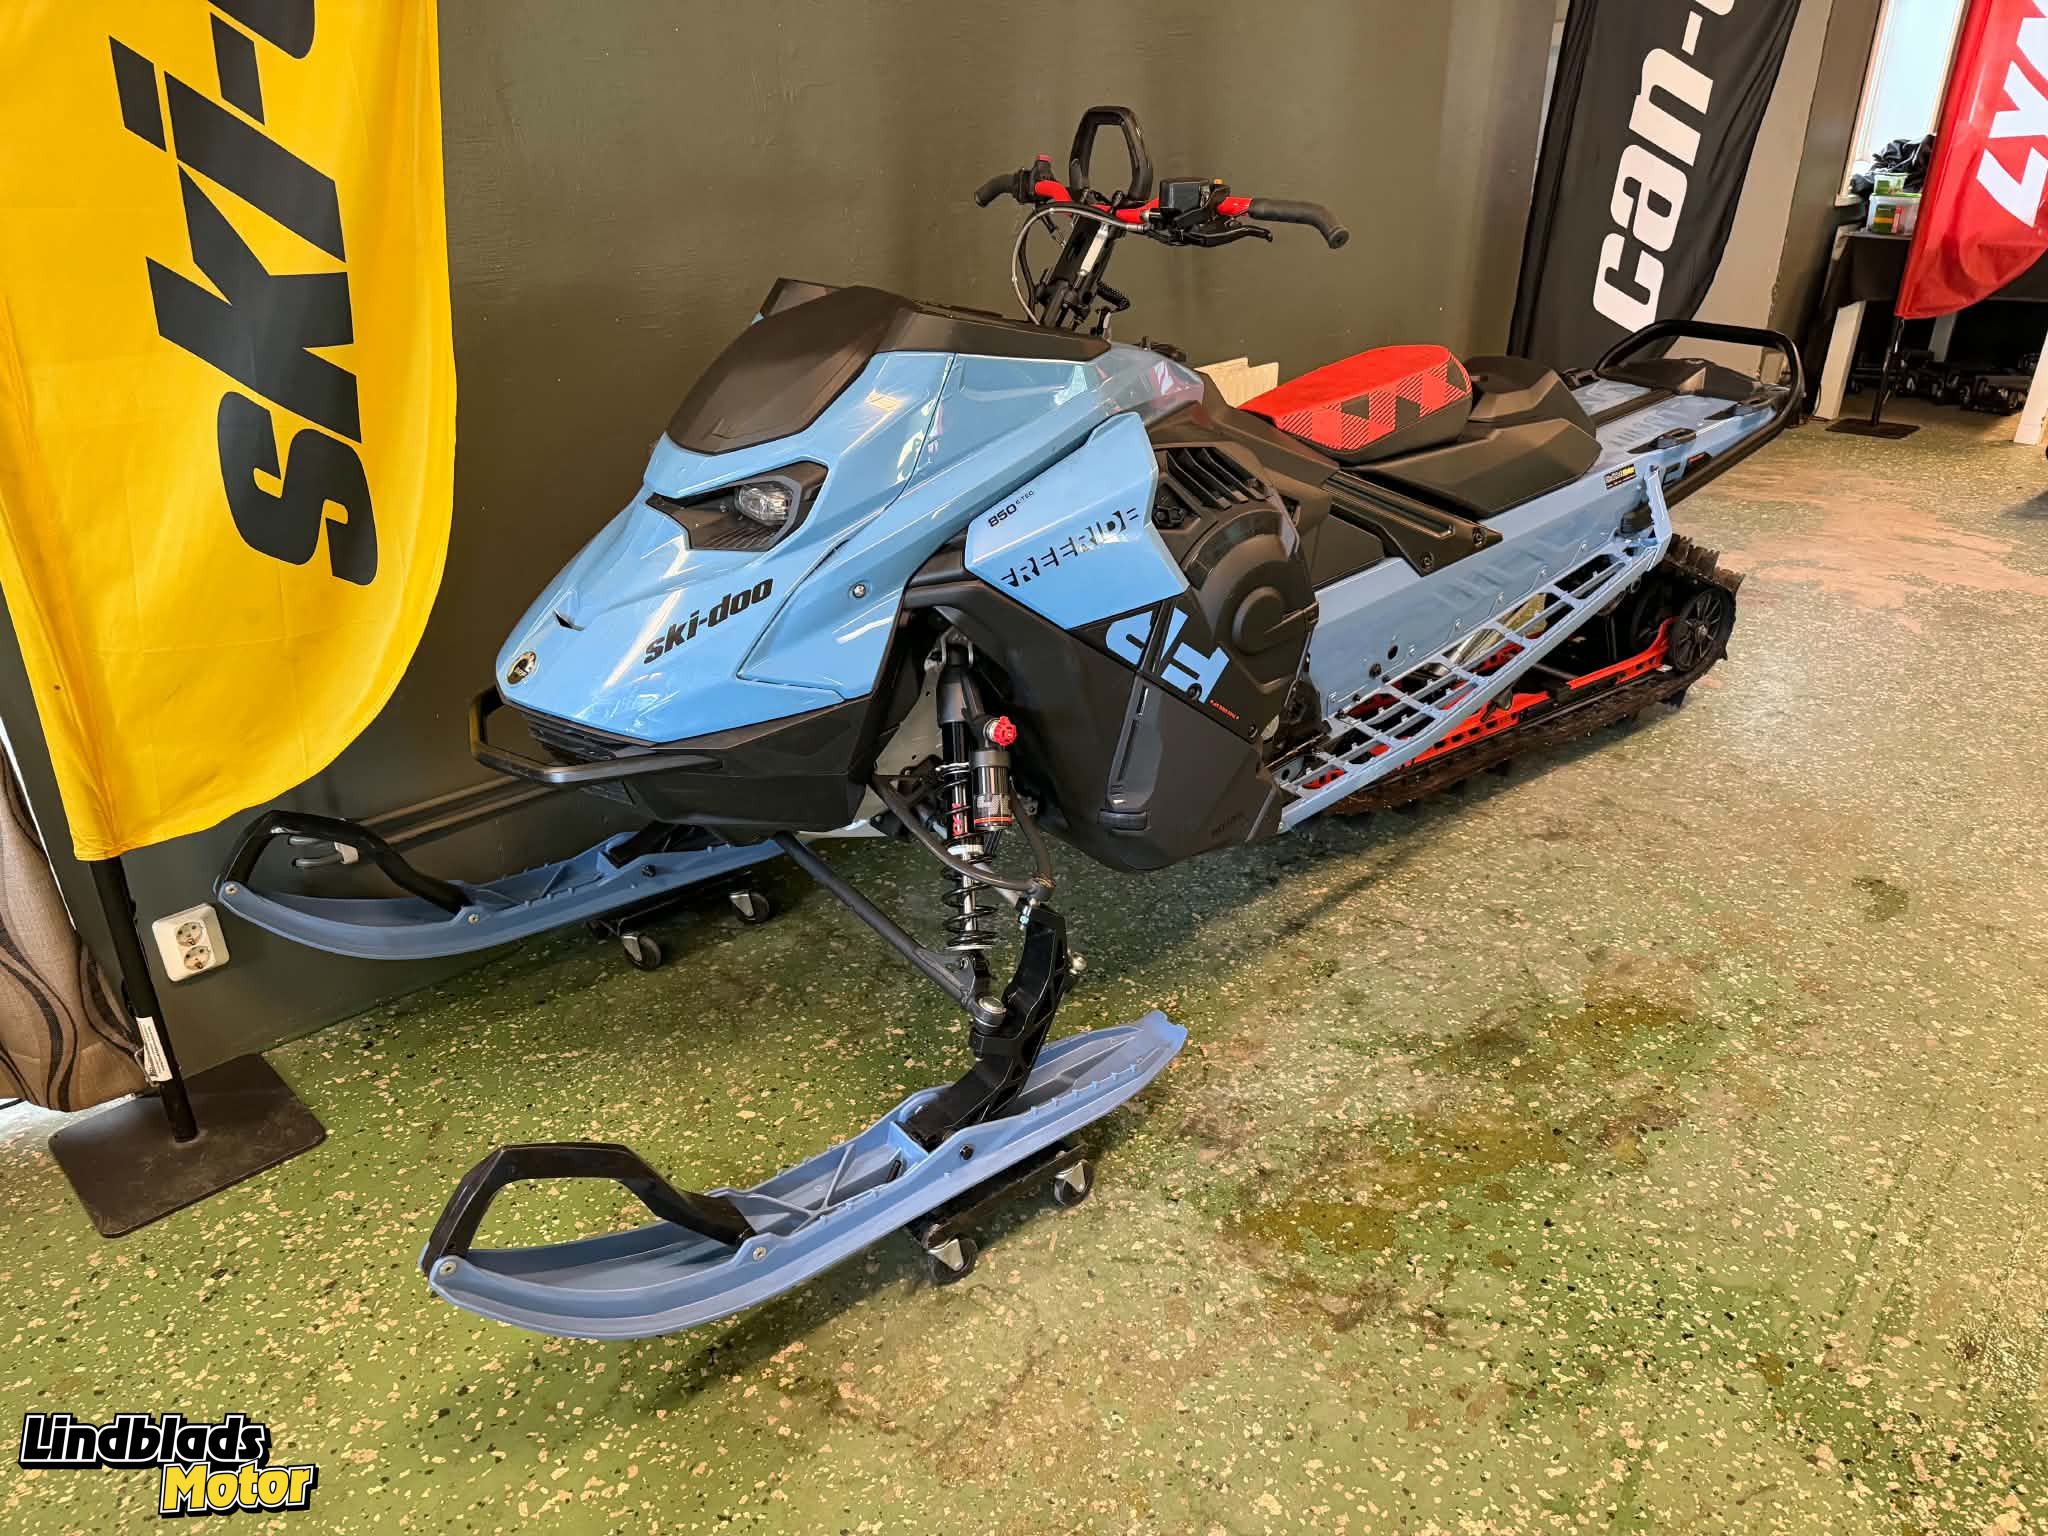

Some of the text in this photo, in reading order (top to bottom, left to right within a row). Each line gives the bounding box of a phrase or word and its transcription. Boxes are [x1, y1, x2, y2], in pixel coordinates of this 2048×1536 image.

[1592, 0, 1738, 333] can-
[108, 0, 378, 586] ski-
[987, 503, 1018, 528] 850
[1000, 507, 1140, 588] FREERIDE
[643, 578, 774, 665] ski-doo
